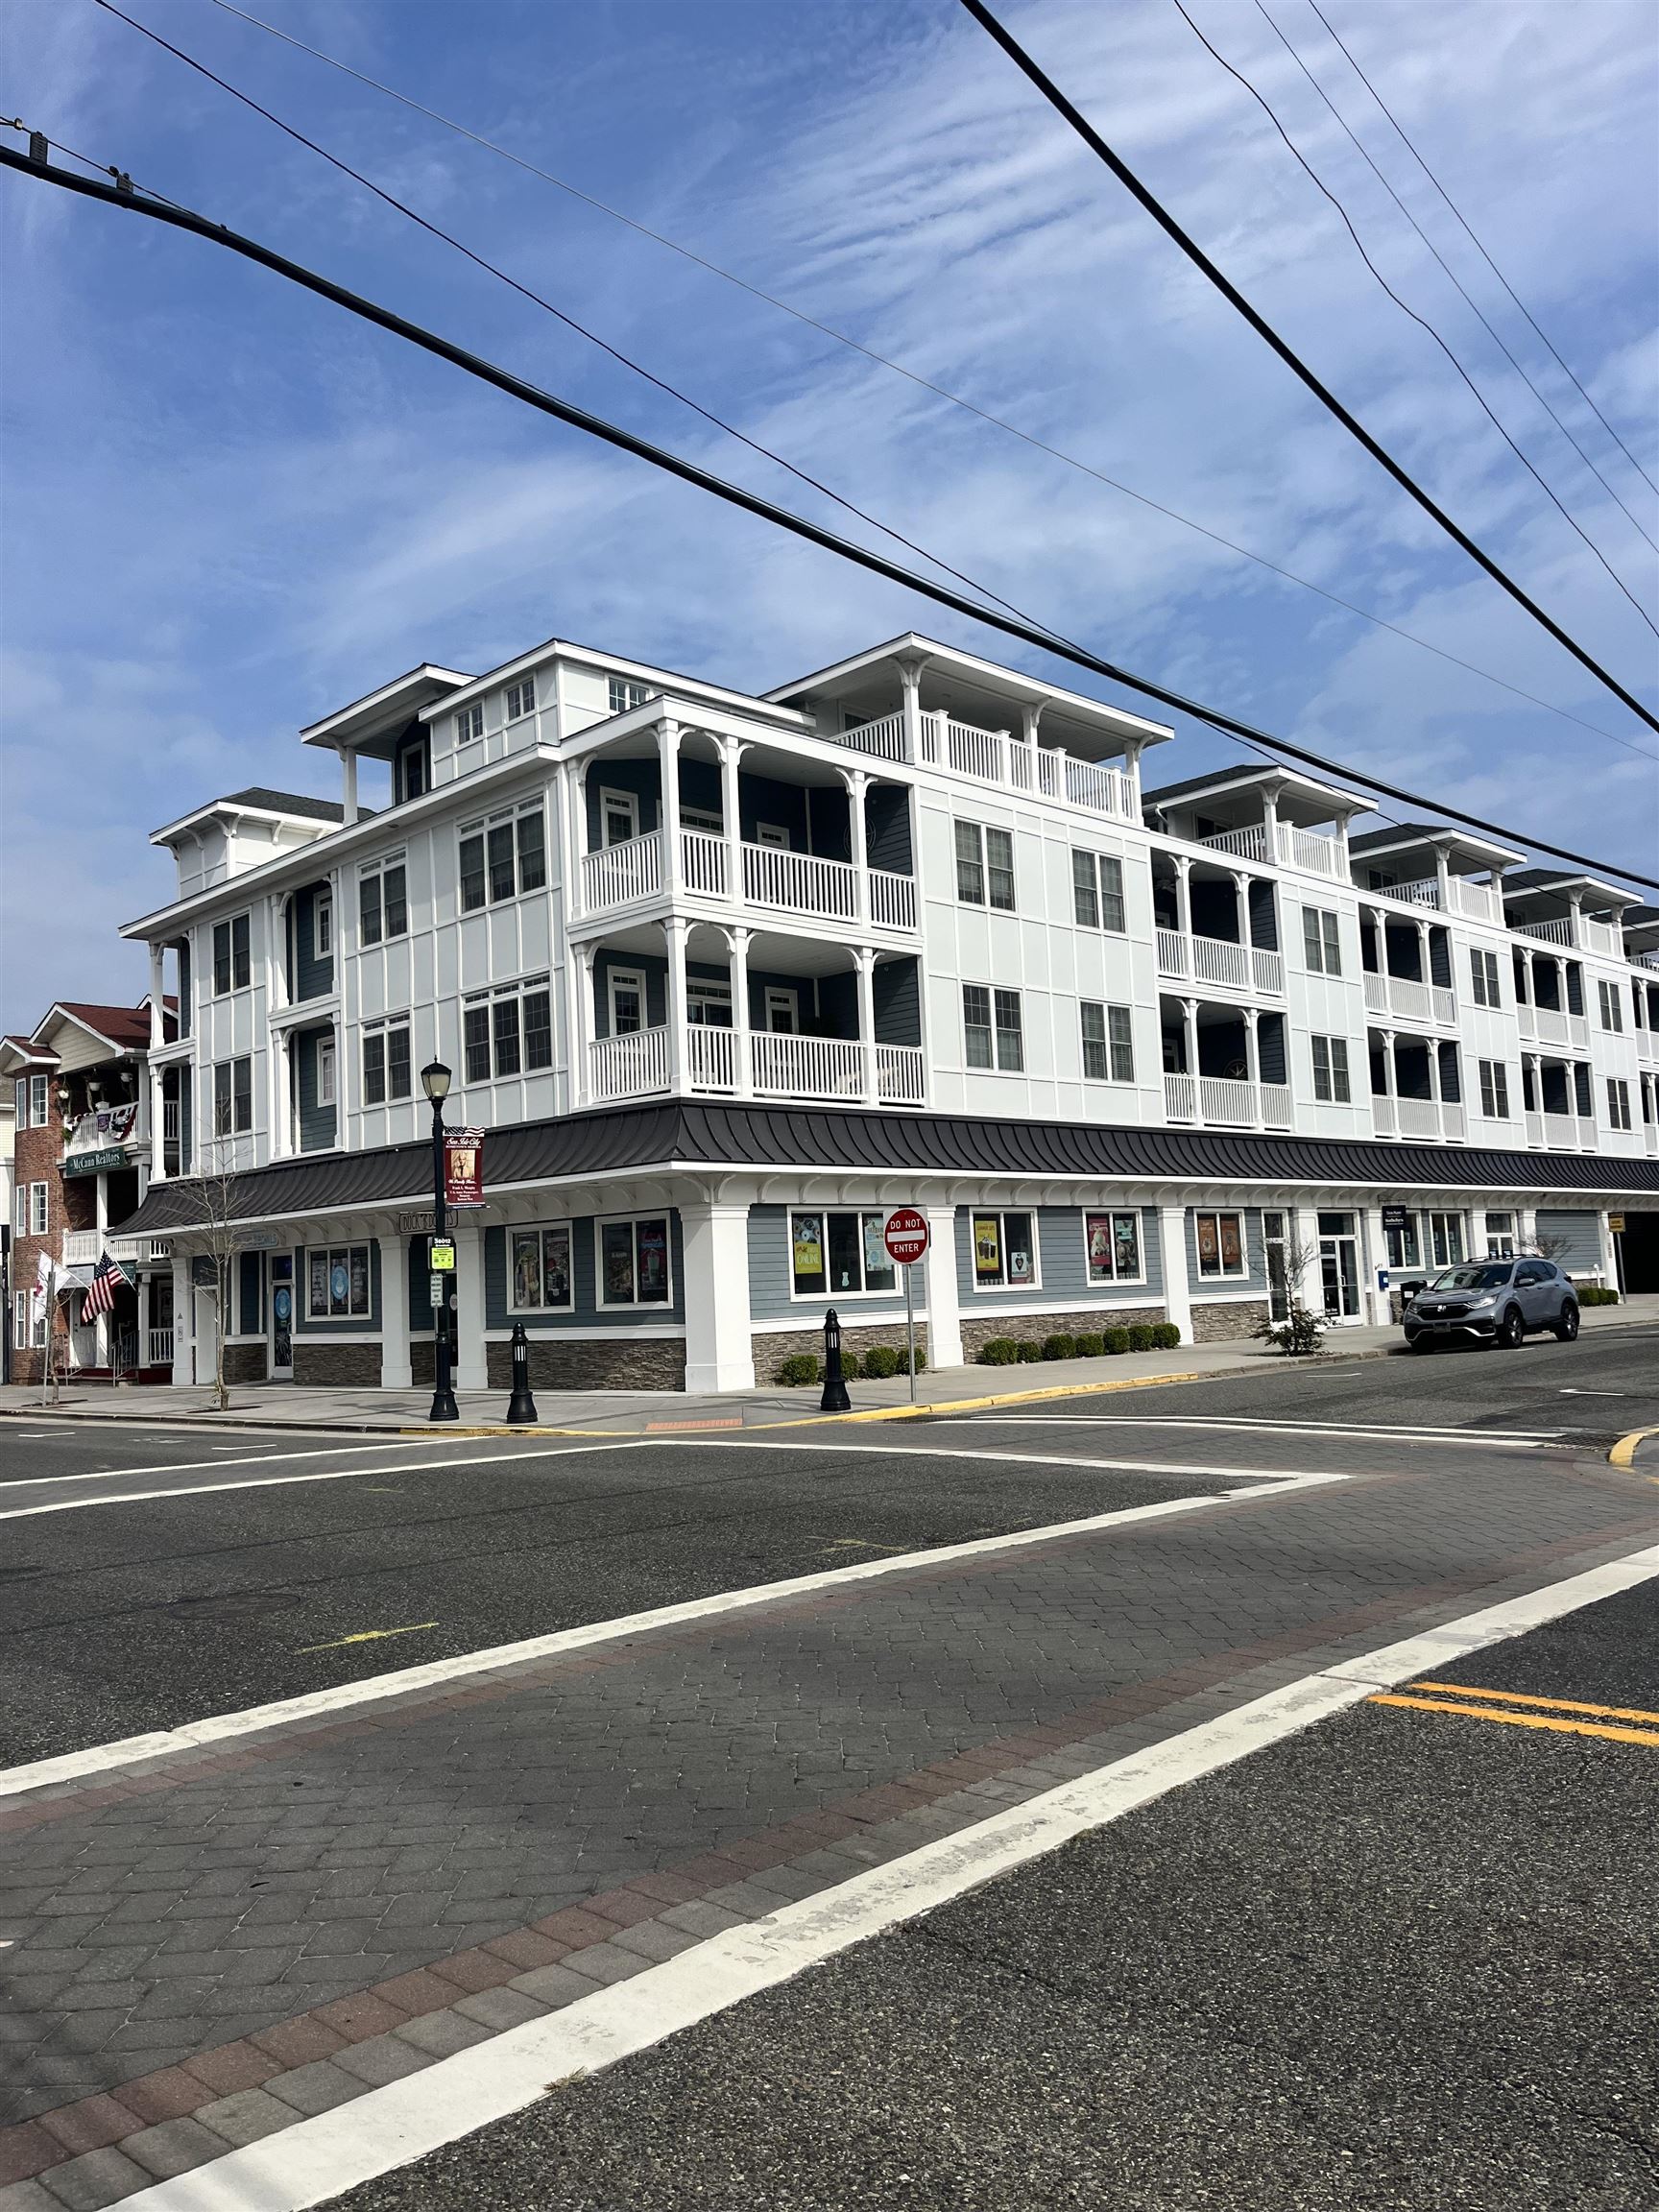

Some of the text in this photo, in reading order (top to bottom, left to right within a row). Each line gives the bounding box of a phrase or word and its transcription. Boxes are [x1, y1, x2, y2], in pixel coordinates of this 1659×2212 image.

[469, 1138, 481, 1146] City
[73, 1153, 120, 1169] McCann Realtors
[403, 1214, 421, 1230] DUCK
[890, 1218, 921, 1230] DO NOT
[894, 1243, 919, 1254] ENTER
